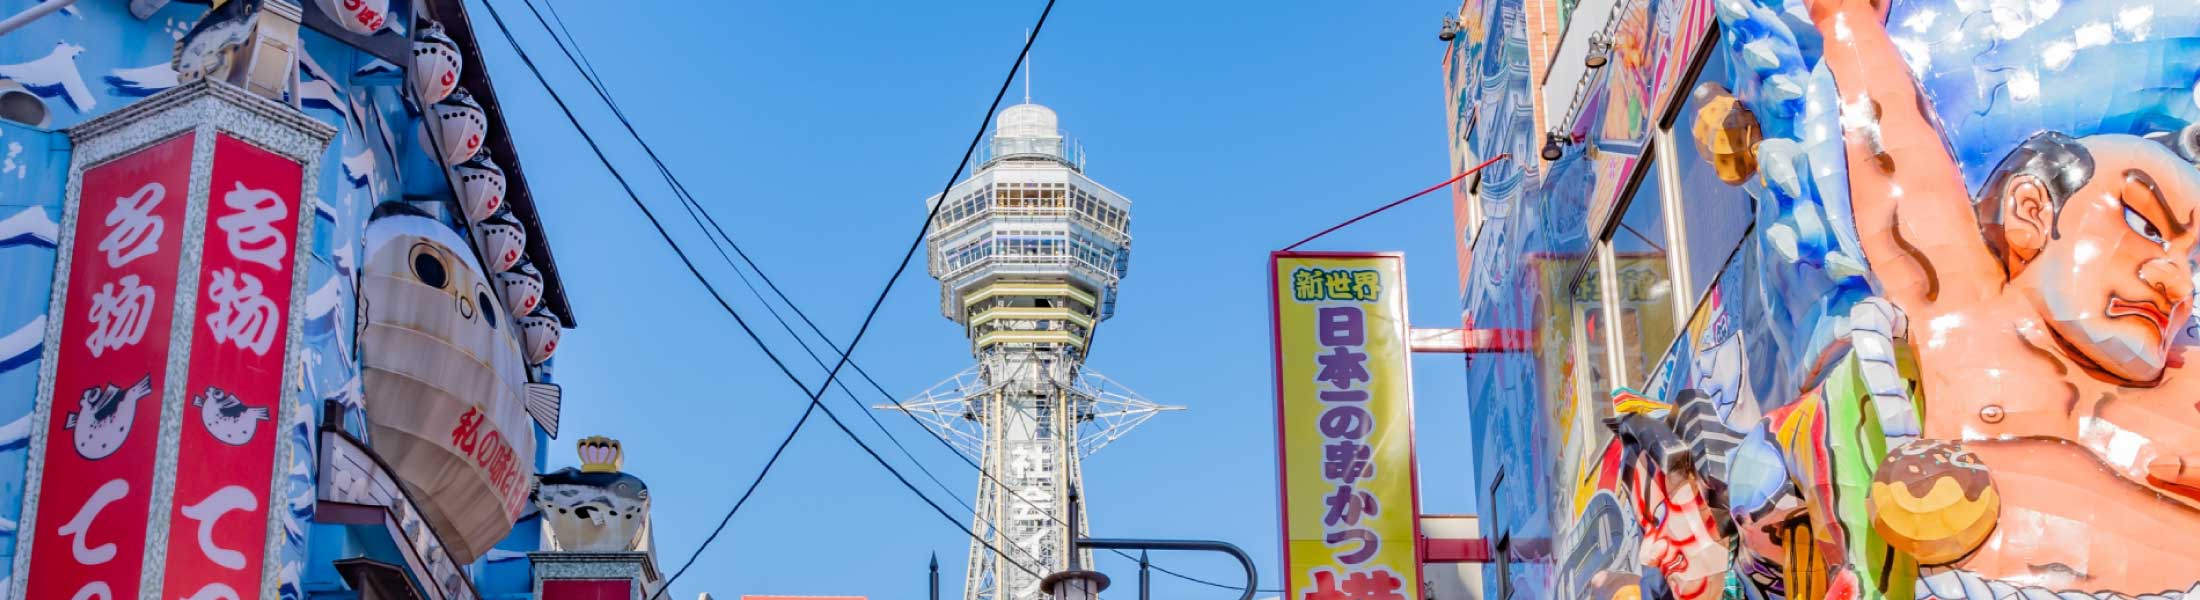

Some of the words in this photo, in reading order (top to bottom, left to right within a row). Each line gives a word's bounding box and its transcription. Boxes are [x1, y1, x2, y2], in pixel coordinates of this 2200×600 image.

[86, 182, 166, 358] 名物
[206, 180, 288, 357] 名物
[1292, 268, 1382, 302] 新世界
[1317, 306, 1379, 564] 日本一の串かつ
[58, 479, 129, 600] て
[180, 485, 258, 600] て
